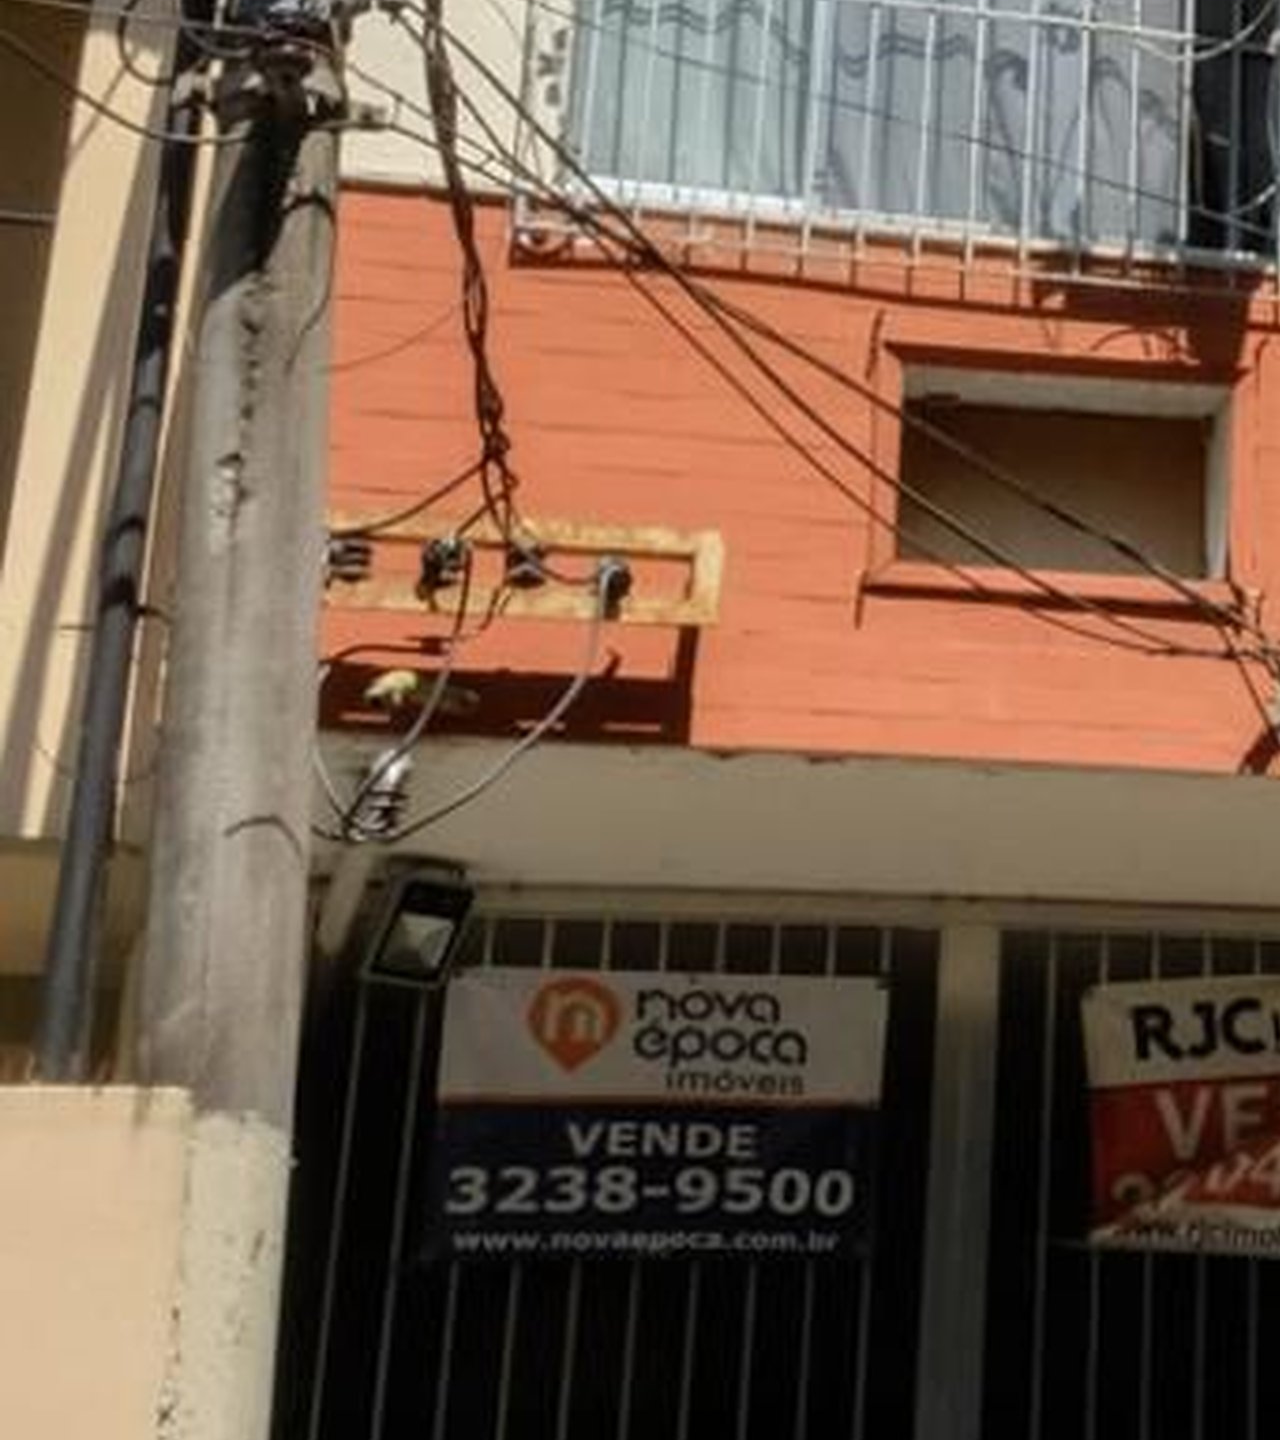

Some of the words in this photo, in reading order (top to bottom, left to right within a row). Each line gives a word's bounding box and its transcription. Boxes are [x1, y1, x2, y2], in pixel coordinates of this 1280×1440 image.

[636, 988, 780, 1023] nova
[1131, 999, 1265, 1059] RJC
[566, 1122, 759, 1158] VENDE
[443, 1166, 855, 1217] 3238-9500
[451, 1227, 840, 1255] www.novaepoca.com.br
